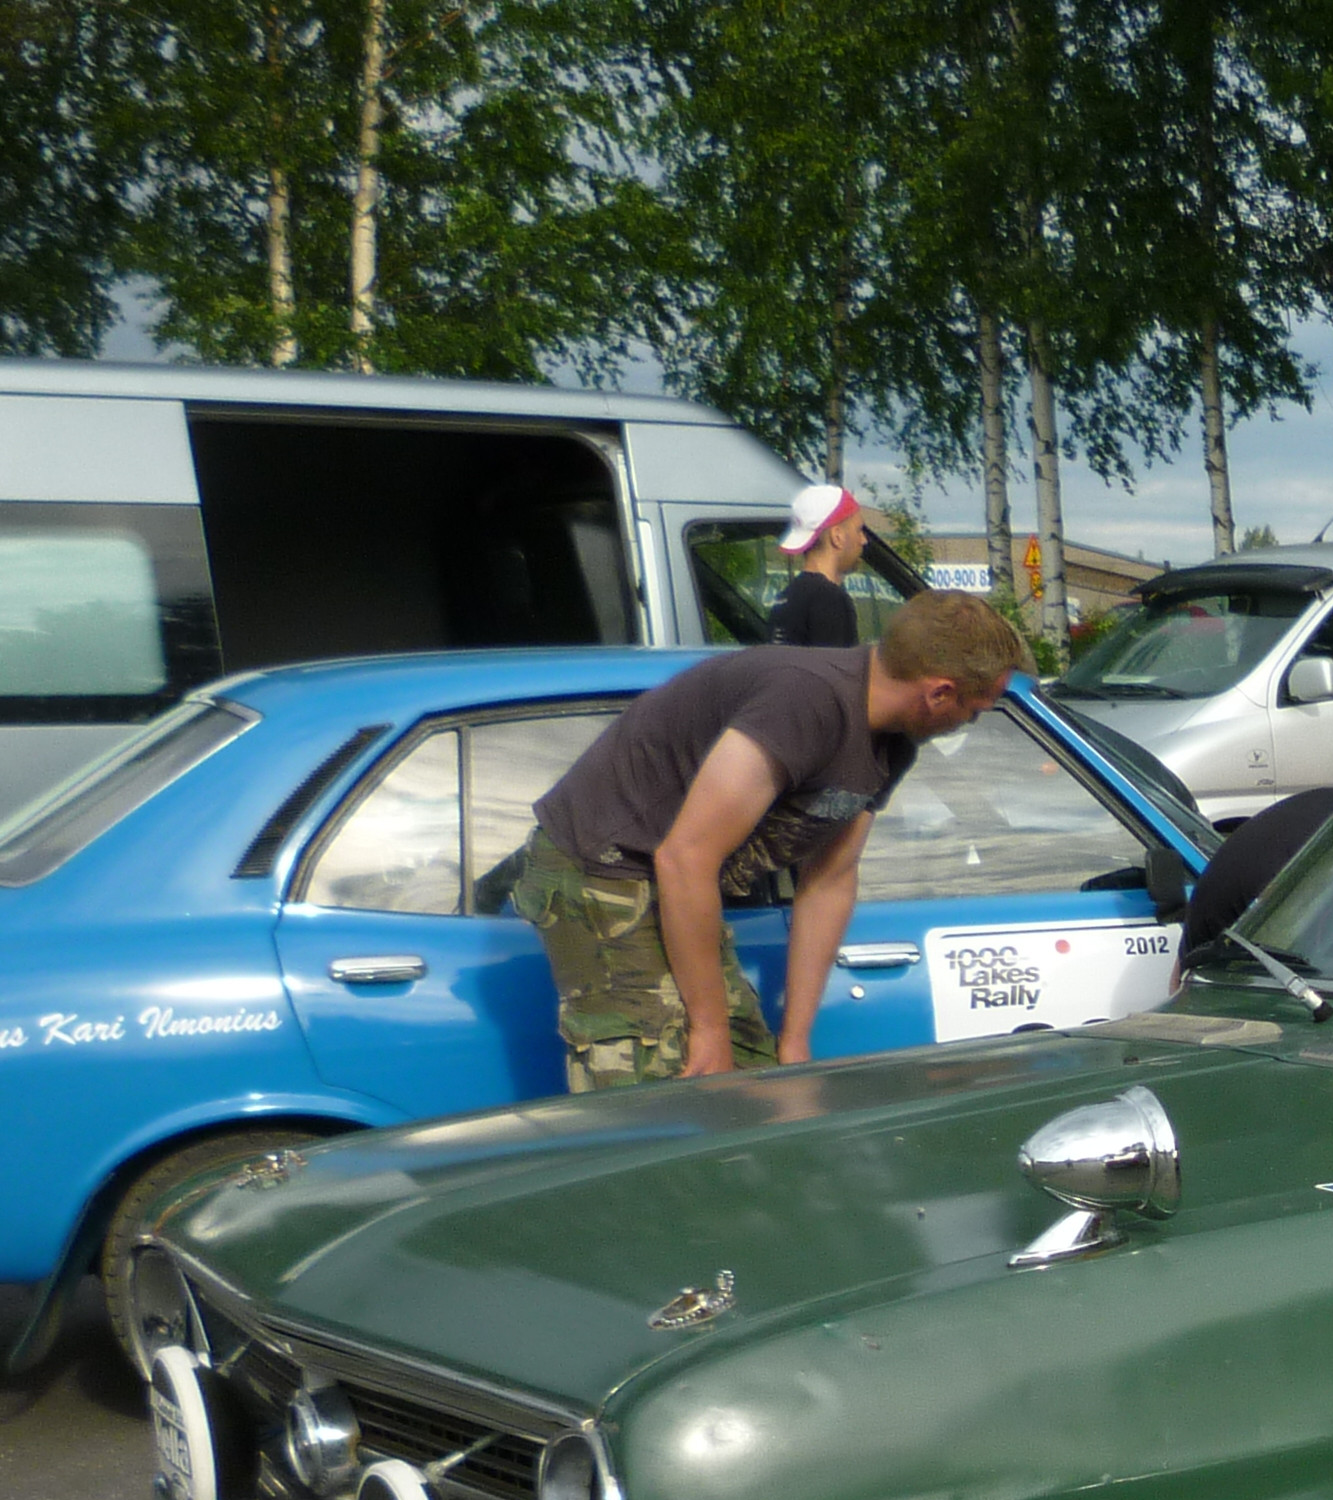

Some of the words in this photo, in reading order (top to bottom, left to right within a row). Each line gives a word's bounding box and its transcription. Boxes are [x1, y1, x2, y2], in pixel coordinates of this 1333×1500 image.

[1124, 935, 1170, 956] 2012
[944, 946, 1019, 970] 1000
[959, 966, 1041, 987] Lakes
[970, 984, 1041, 1010] Rally
[39, 1013, 126, 1046] Kari
[138, 1006, 282, 1039] Ilmonius
